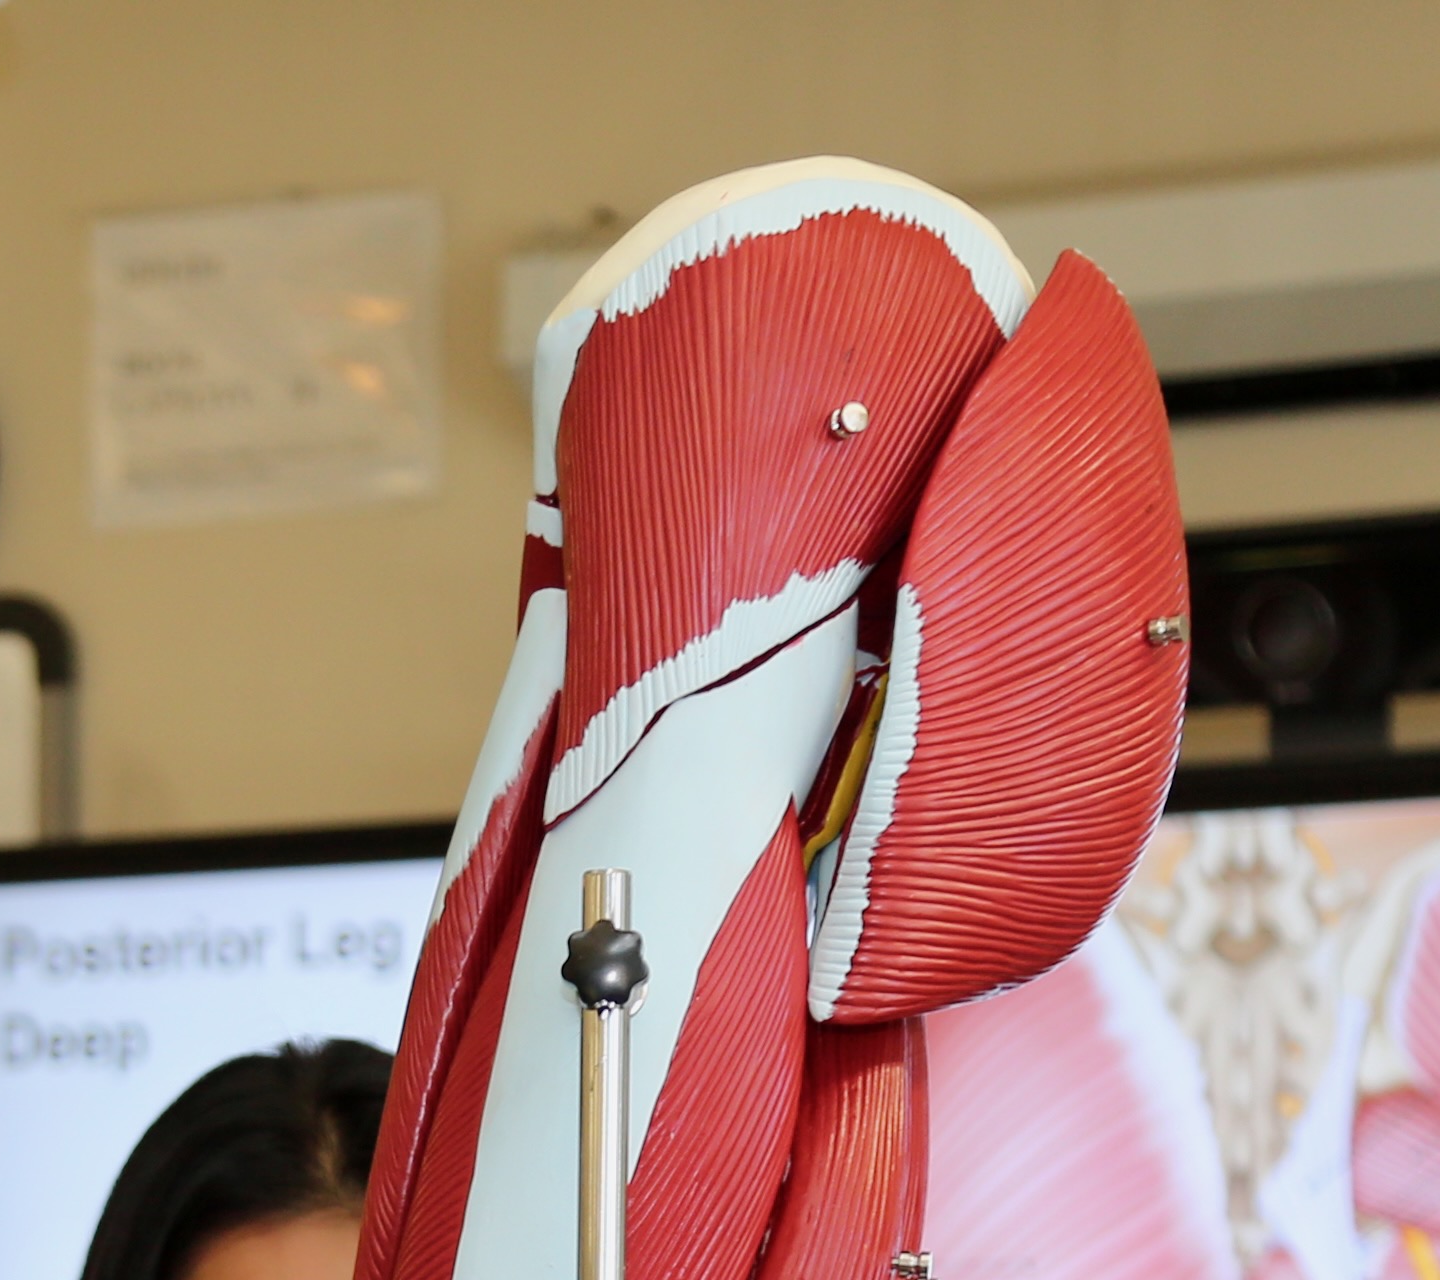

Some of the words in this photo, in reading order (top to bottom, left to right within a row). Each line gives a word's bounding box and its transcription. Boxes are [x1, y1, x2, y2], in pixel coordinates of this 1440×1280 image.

[1, 919, 272, 977] Posterior
[291, 914, 405, 977] Leg
[0, 1012, 148, 1070] Deep
